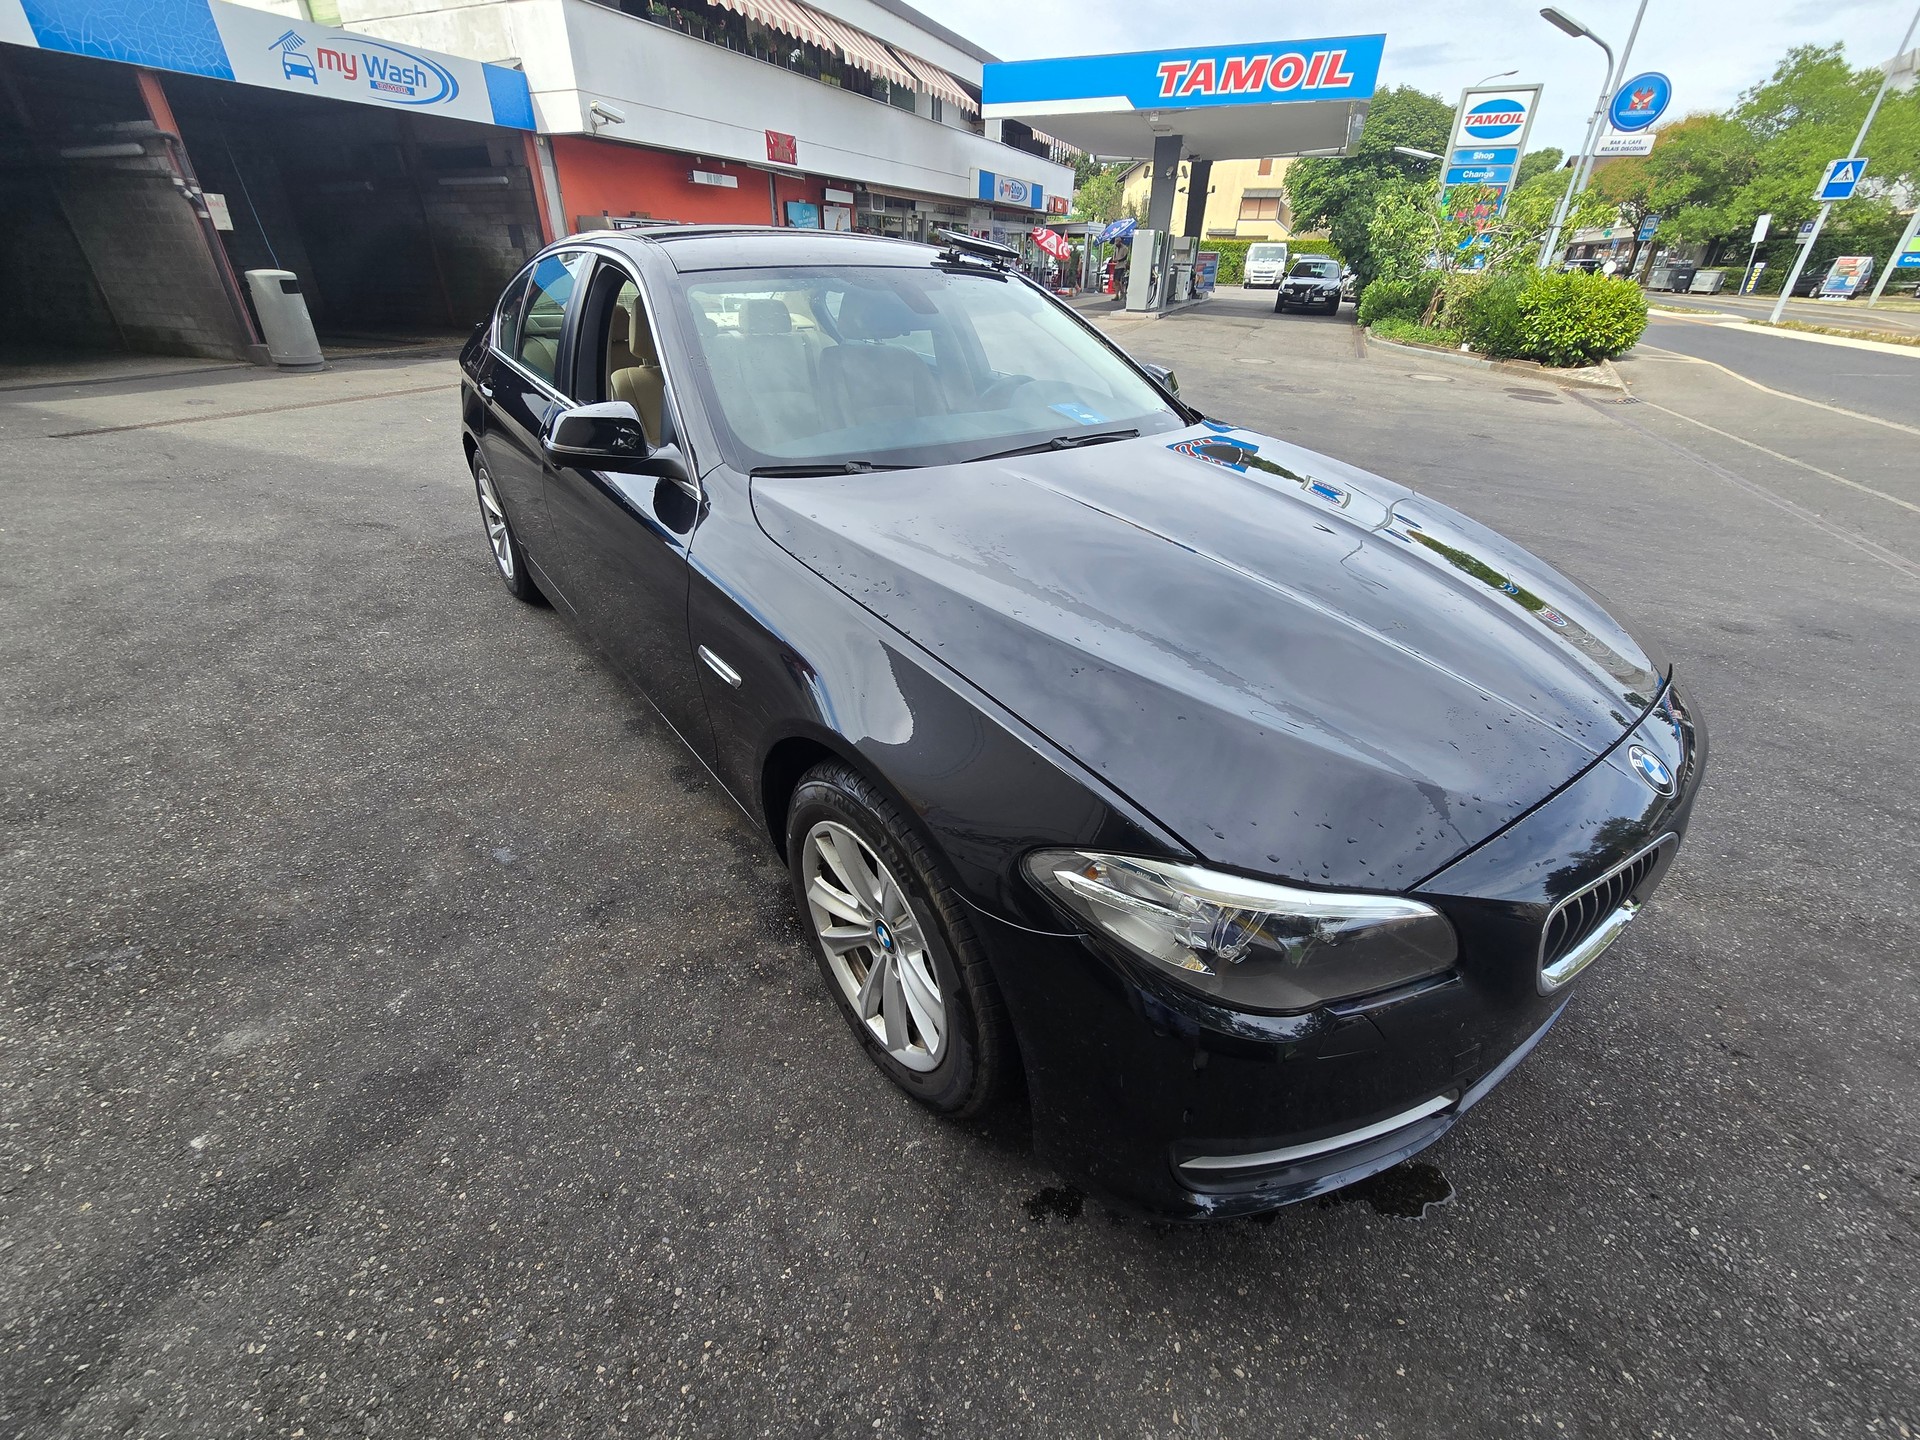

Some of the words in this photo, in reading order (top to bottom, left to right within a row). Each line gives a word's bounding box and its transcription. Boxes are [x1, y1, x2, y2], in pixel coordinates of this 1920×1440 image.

[317, 48, 358, 81] my
[362, 53, 427, 88] Wash
[1157, 50, 1354, 97] TAMOIL
[376, 82, 410, 94] TAMOIL
[1464, 113, 1524, 126] TAMOIL
[1473, 152, 1495, 160] Shop
[1462, 170, 1495, 179] Change
[1804, 223, 1813, 232] P
